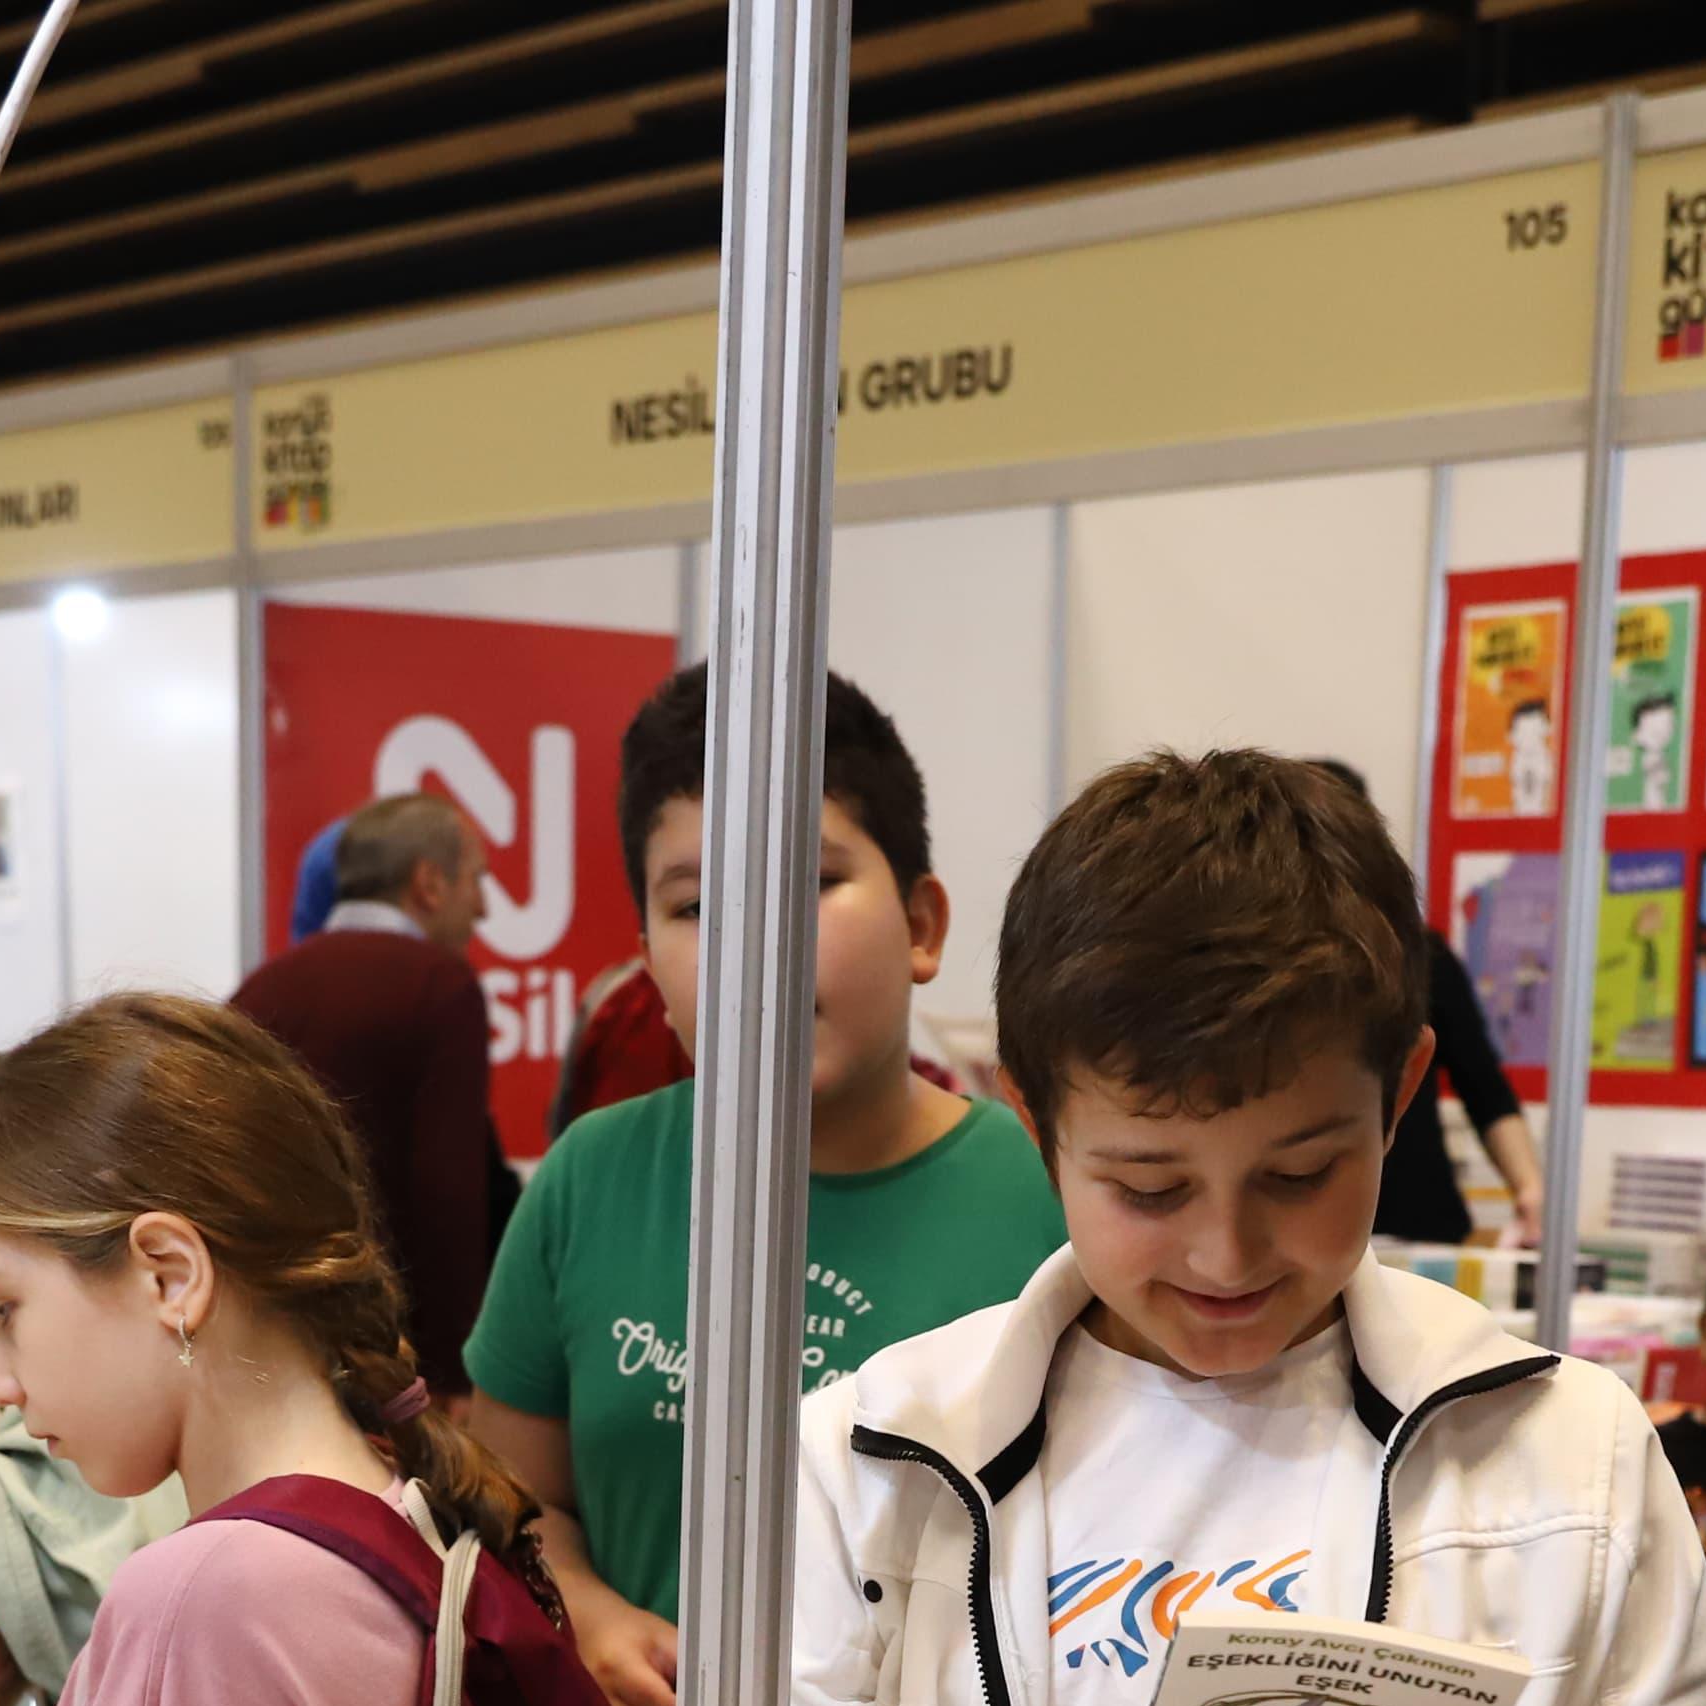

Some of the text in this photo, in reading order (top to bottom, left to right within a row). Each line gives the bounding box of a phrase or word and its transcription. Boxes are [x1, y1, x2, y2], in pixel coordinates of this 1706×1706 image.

[1505, 204, 1568, 251] 105
[861, 346, 1015, 414] GRUBU
[806, 1262, 874, 1318] ODUCT
[803, 1313, 847, 1338] EAR
[1186, 1650, 1499, 1706] EŞEKLİĞİNİ UNUTAN
[1227, 1632, 1477, 1681] Koray Avcı Çakman
[1295, 1673, 1375, 1698] EŞEK
